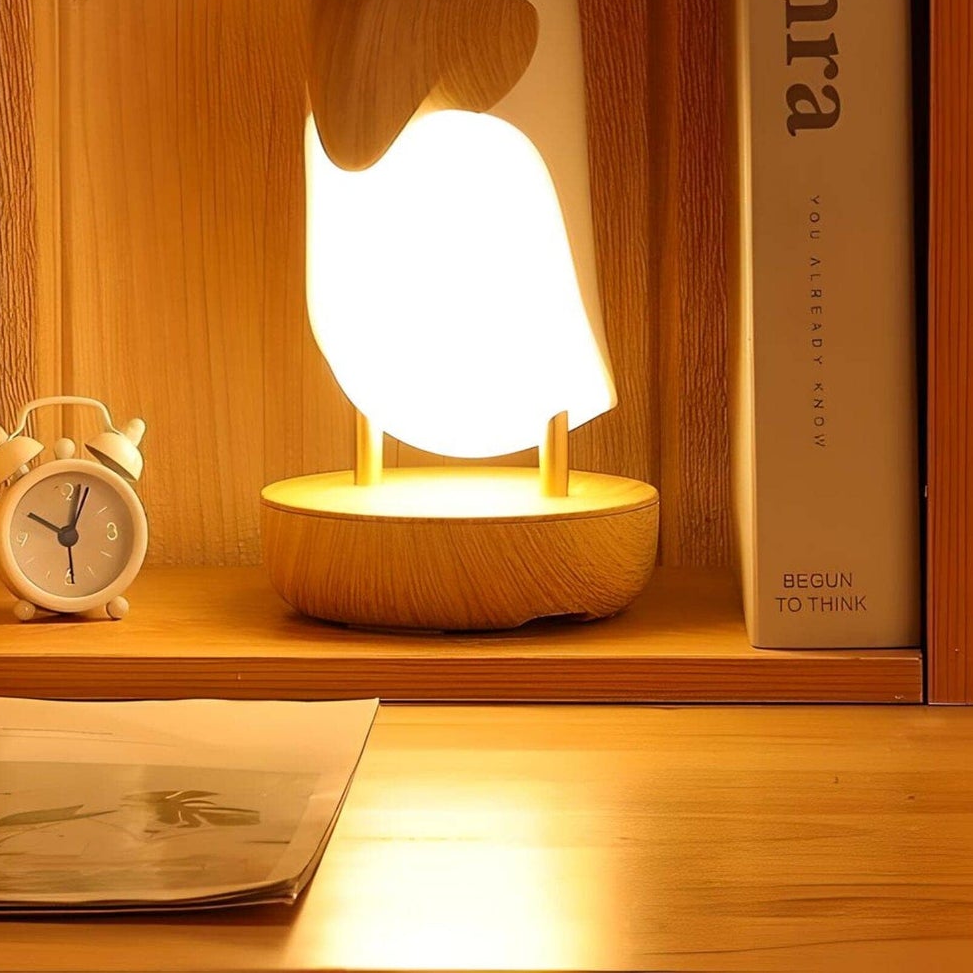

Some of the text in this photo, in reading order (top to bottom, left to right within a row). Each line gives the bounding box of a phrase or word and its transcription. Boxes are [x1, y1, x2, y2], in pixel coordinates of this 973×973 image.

[810, 195, 828, 448] YOU ALREADY KNOW
[106, 522, 119, 541] 3
[783, 572, 853, 589] BEGUN
[775, 595, 867, 613] TO THINK
